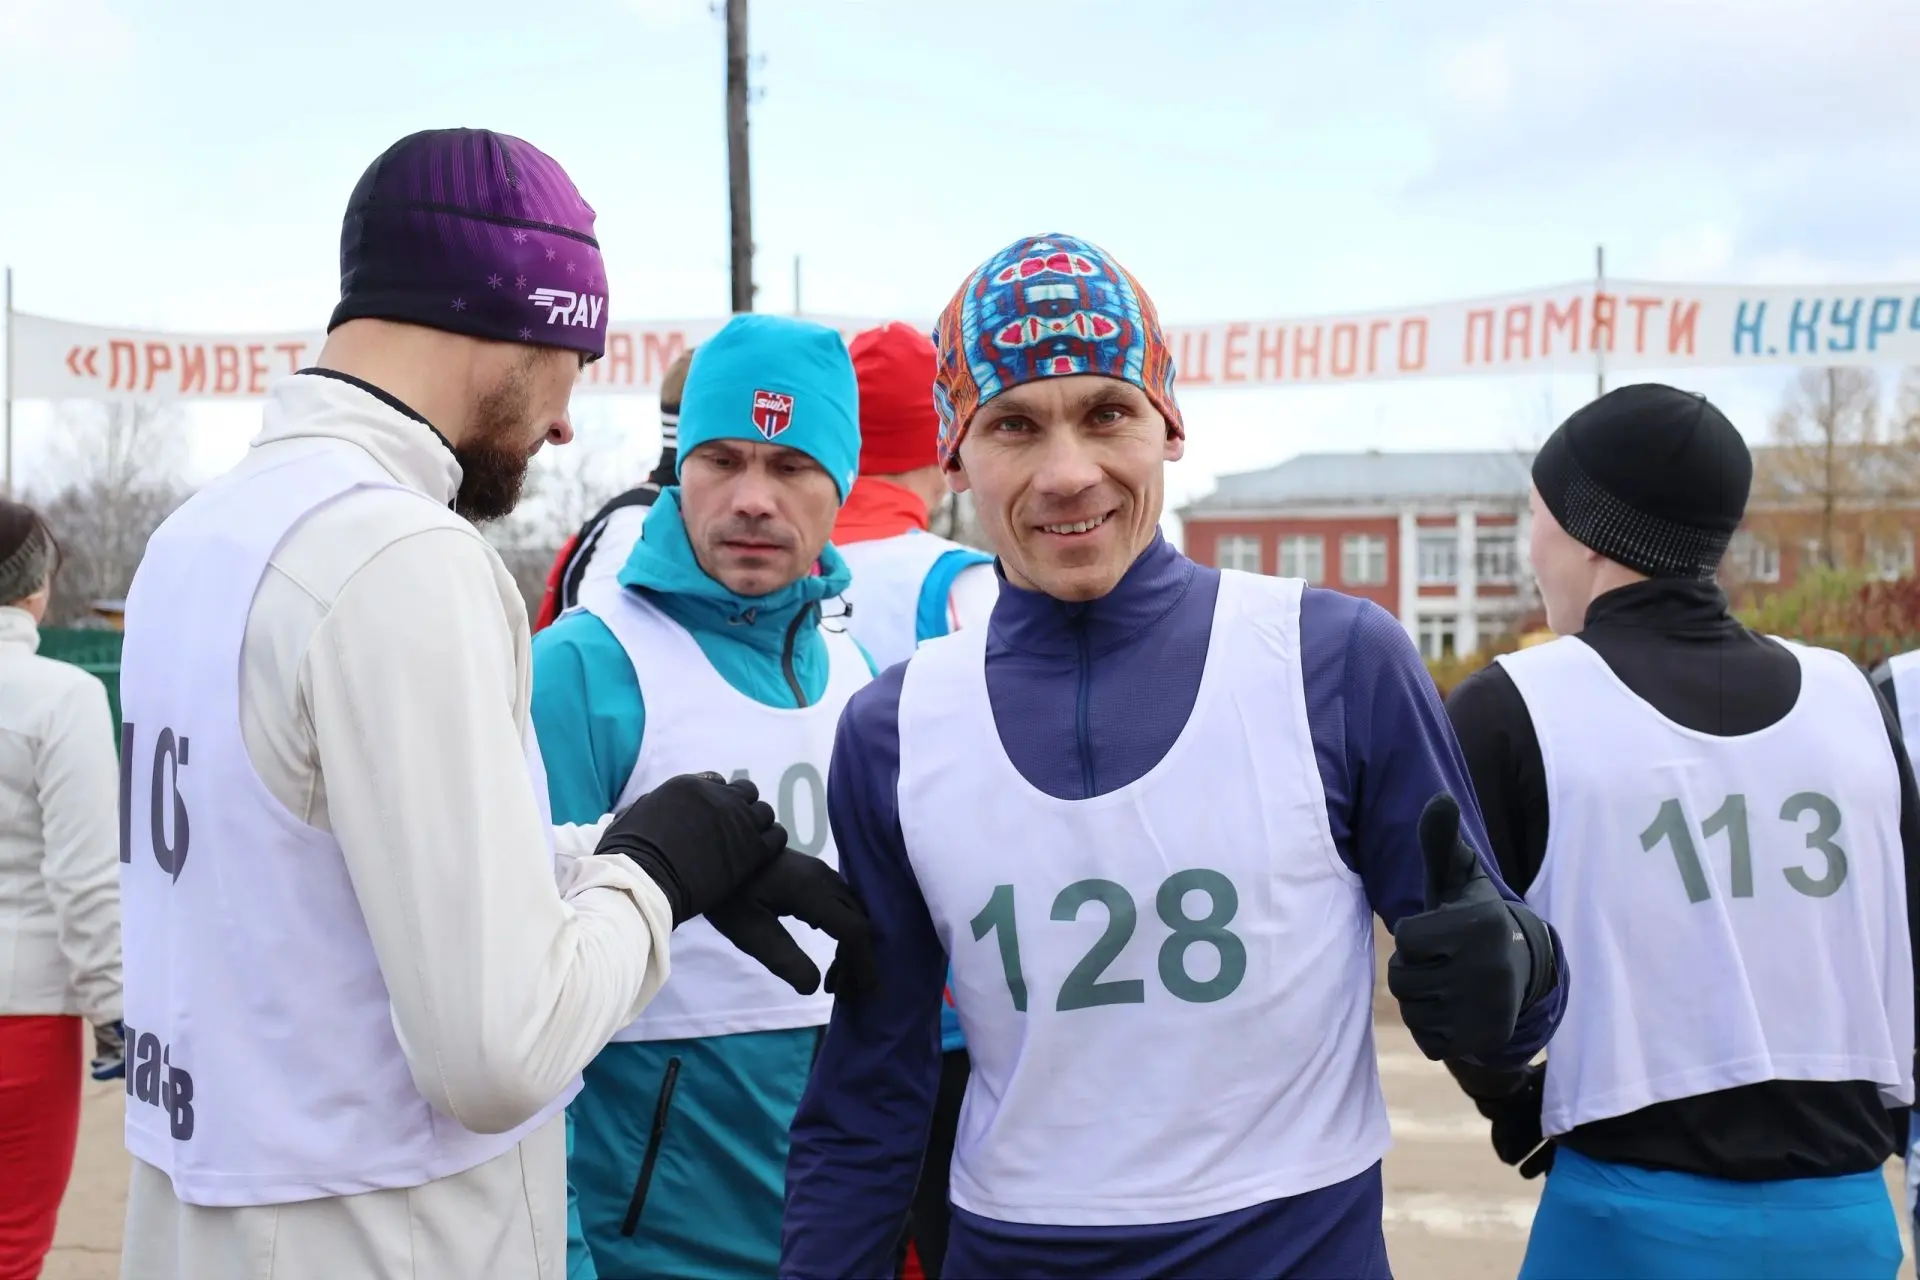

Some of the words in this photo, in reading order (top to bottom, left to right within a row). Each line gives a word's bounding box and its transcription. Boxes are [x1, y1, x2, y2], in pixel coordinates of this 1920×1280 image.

[528, 287, 603, 329] RAY
[1464, 294, 1701, 364] ПАМЯТИ
[1639, 791, 1848, 904] 113
[970, 868, 1247, 1012] 128
